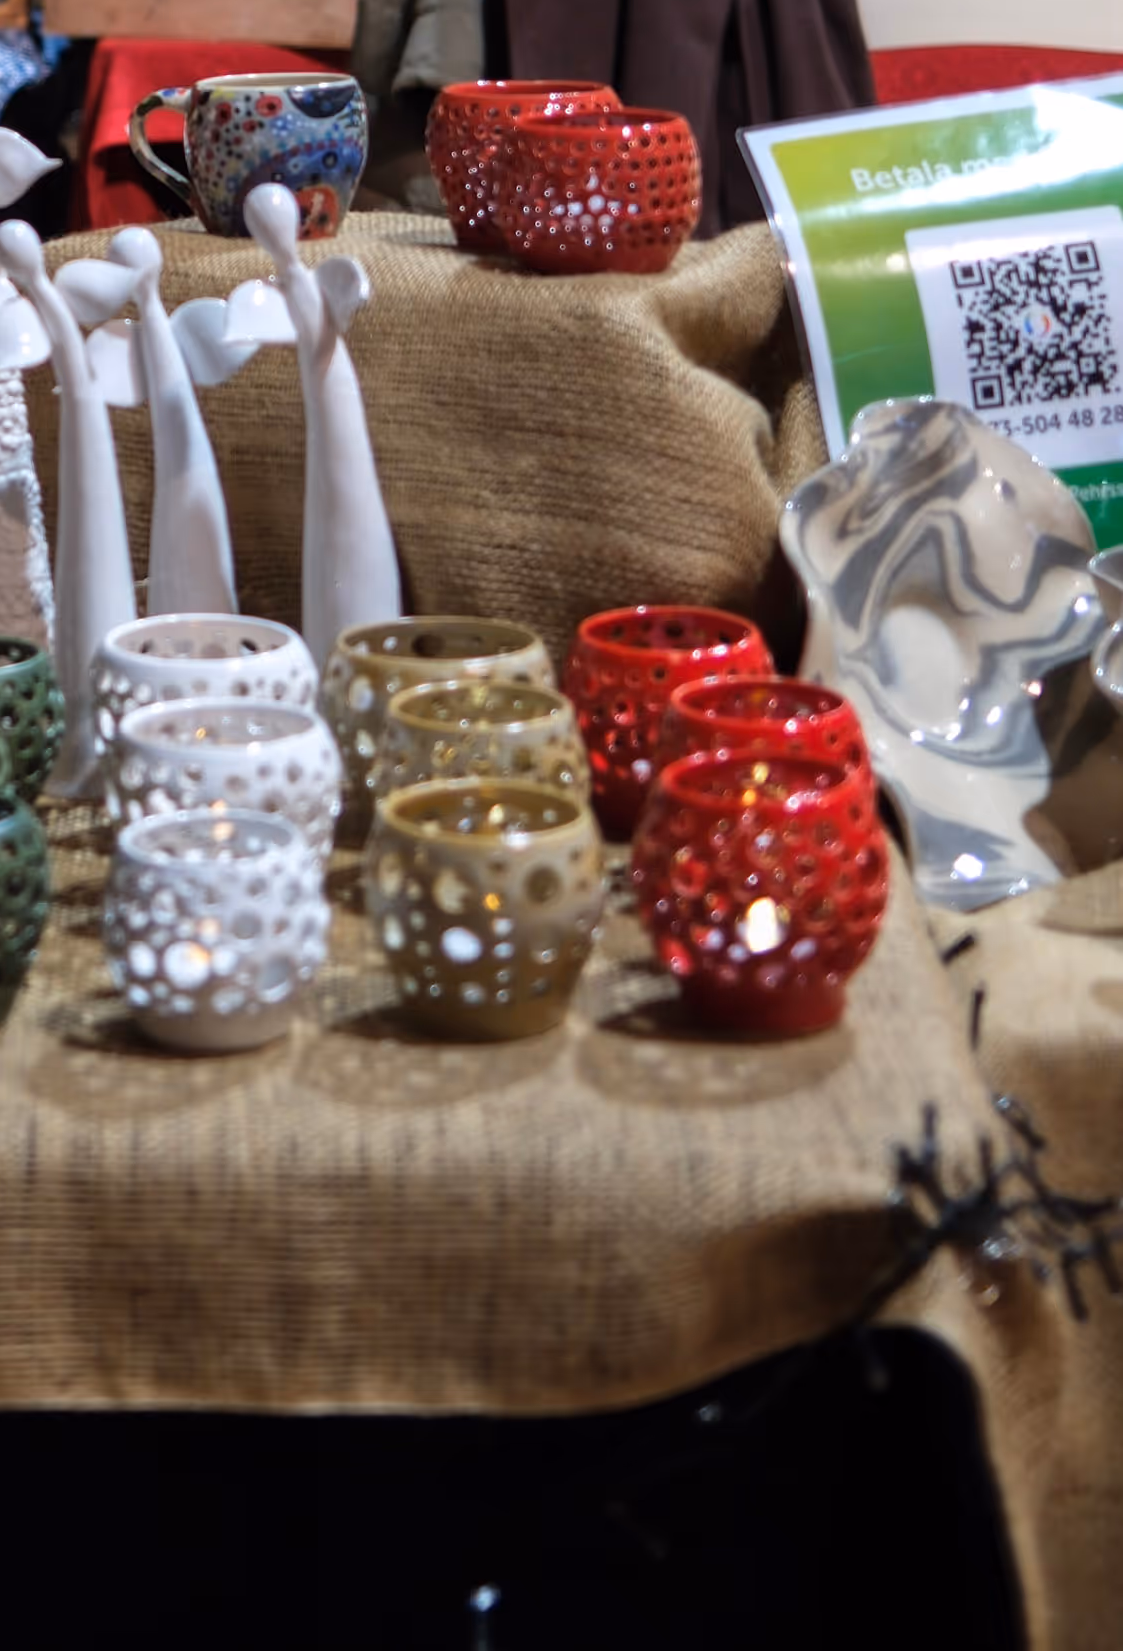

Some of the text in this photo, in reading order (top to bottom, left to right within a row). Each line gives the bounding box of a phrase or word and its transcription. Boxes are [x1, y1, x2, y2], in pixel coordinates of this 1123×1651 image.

[850, 159, 953, 193] Betala
[1067, 408, 1094, 428] 48
[1100, 404, 1123, 426] 28
